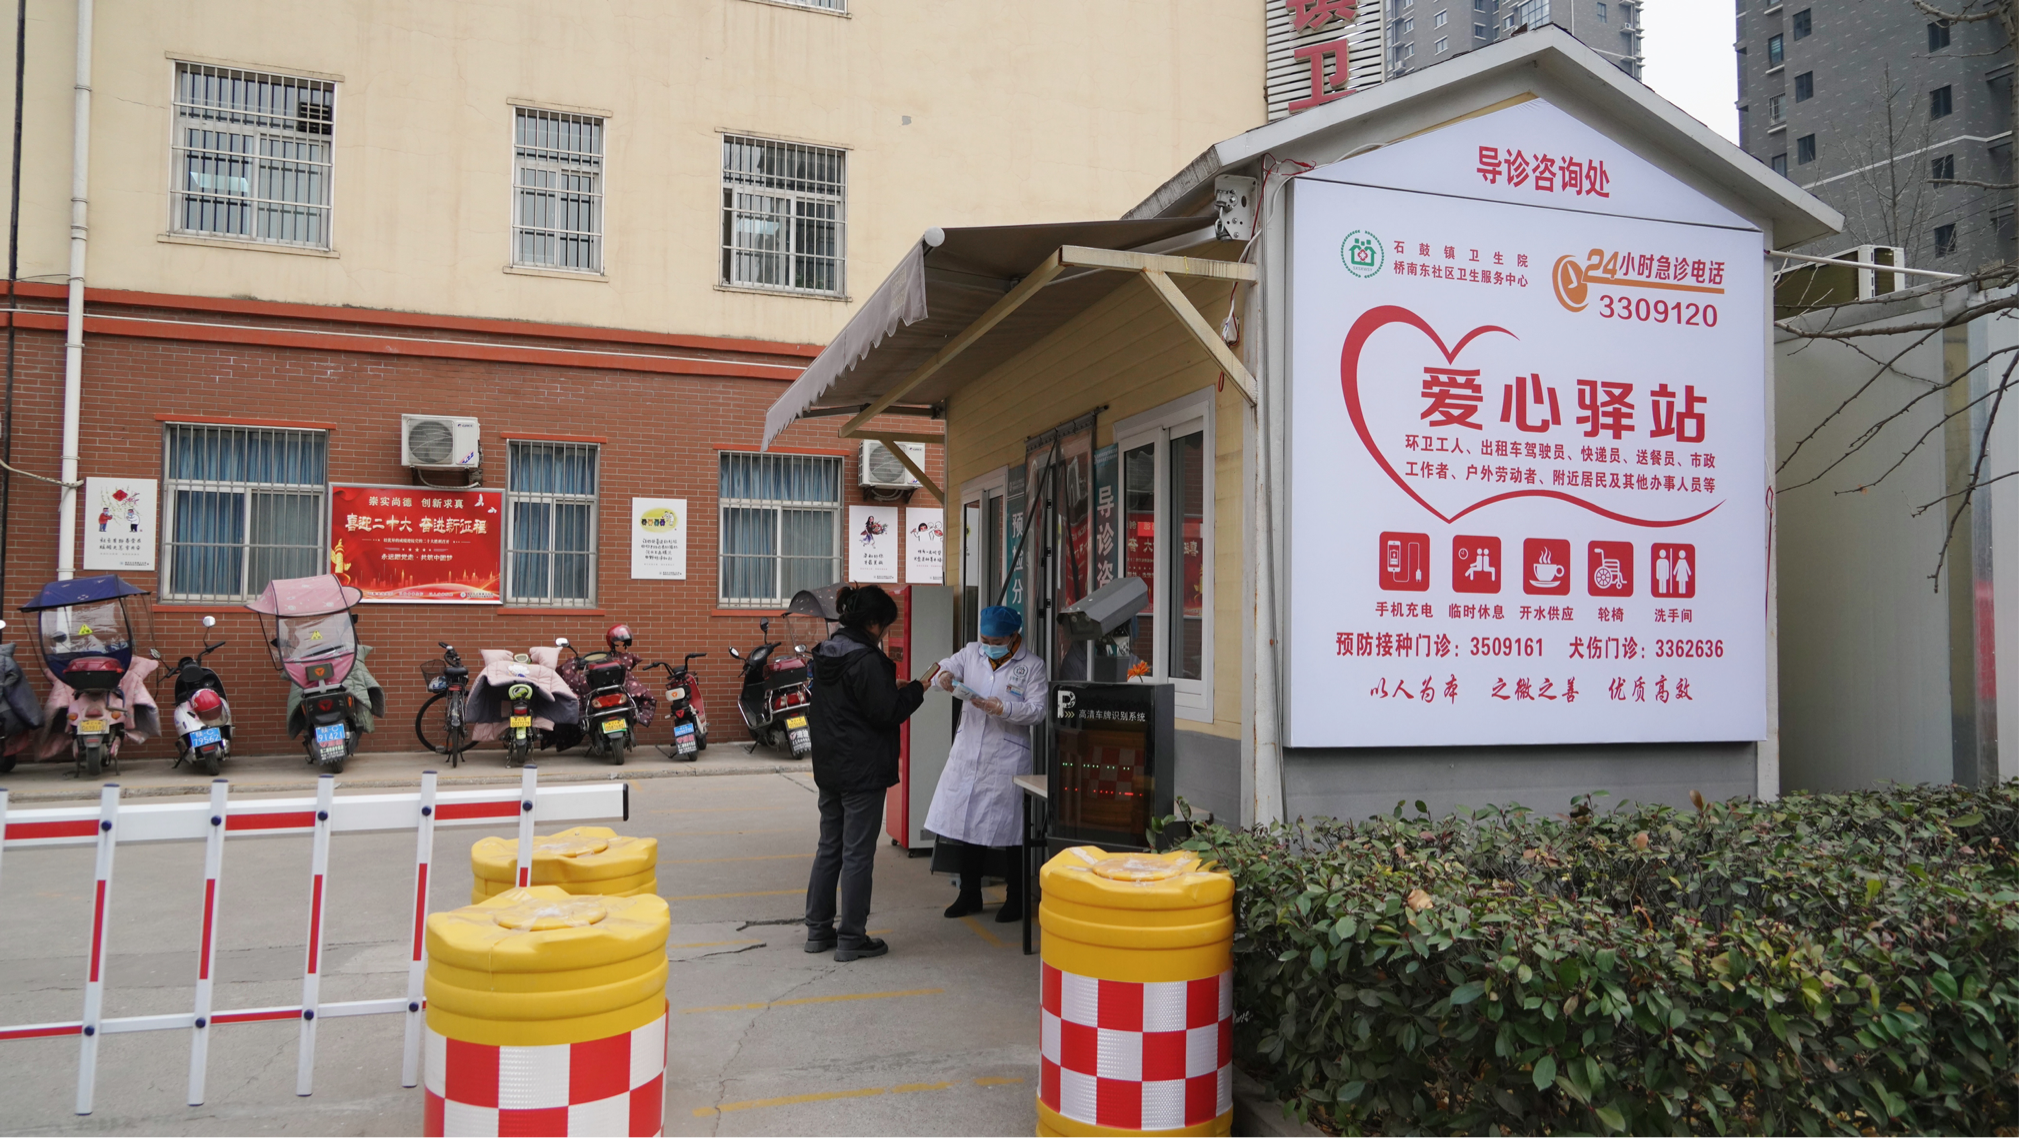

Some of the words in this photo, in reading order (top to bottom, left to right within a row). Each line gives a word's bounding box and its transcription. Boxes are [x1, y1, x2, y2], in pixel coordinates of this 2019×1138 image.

[1476, 146, 1610, 198] 导诊咨询处
[1393, 240, 1529, 268] 石鼓镇卫生院
[1582, 248, 1725, 285] 24小时急诊电话
[1393, 260, 1529, 288] 桥南东社区卫生服务中心
[1599, 294, 1718, 328] 3309120
[1420, 366, 1708, 444] 爱心驿站
[1405, 434, 1716, 469] 环卫工人、出租车驾驶员、快递员、送餐员、市政
[1405, 460, 1716, 494] 工作者、户外劳动者、附近居民及其他办事人员等
[368, 496, 413, 508] 崇实尚德
[421, 498, 464, 510] 创新求真
[345, 513, 413, 533] 喜迎二十大
[419, 516, 487, 535] 奋进新征程
[1375, 601, 1434, 618] 手机充电
[1449, 603, 1505, 620] 临时休息
[1519, 605, 1574, 622] 开水供应
[1598, 606, 1624, 622] 轮椅
[1654, 608, 1693, 623] 洗手间
[1370, 673, 1459, 704] 以人为本
[1609, 674, 1693, 704] 优质高效
[1078, 709, 1146, 721] 高清车牌识别系统
